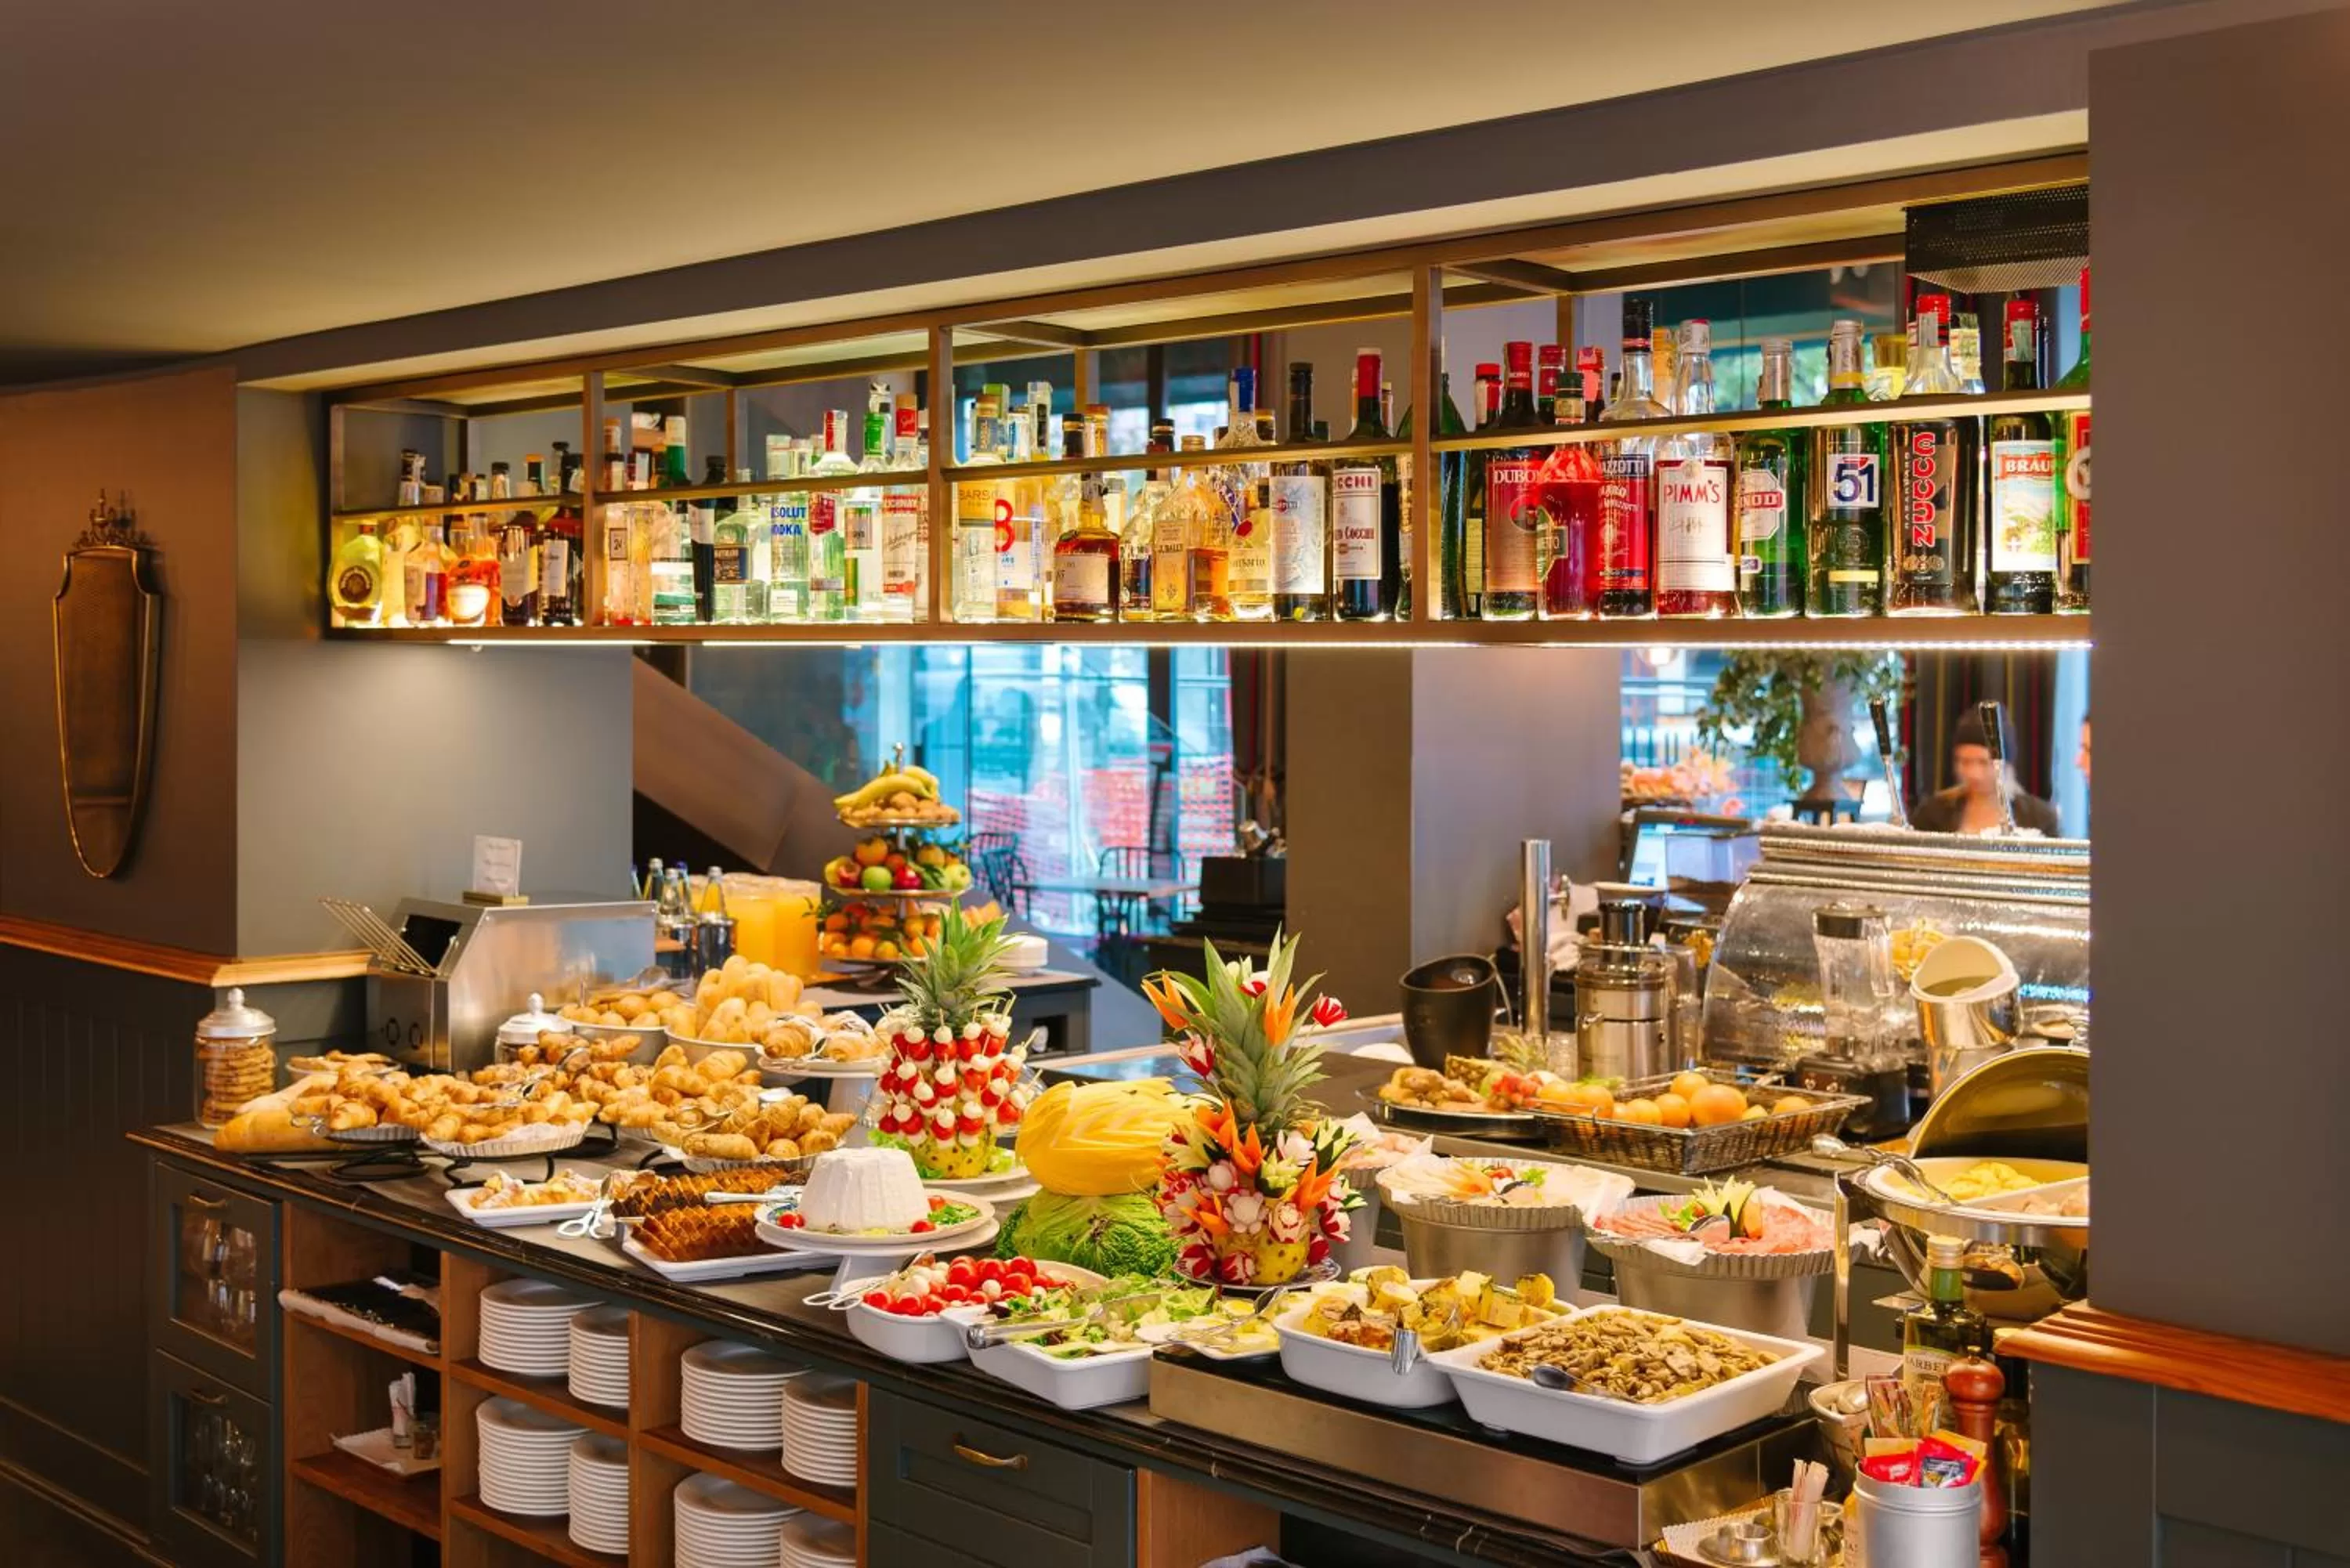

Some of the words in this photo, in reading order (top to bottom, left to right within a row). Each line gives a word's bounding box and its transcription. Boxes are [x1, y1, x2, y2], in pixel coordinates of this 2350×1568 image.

[2006, 459, 2050, 472] BRAU
[1335, 475, 1372, 490] CCHI
[1833, 463, 1875, 502] 51
[1913, 432, 1936, 547] ZUCCA
[1663, 479, 1722, 503] PIMM'S
[771, 507, 806, 518] SOLUT
[771, 524, 803, 536] ODKA
